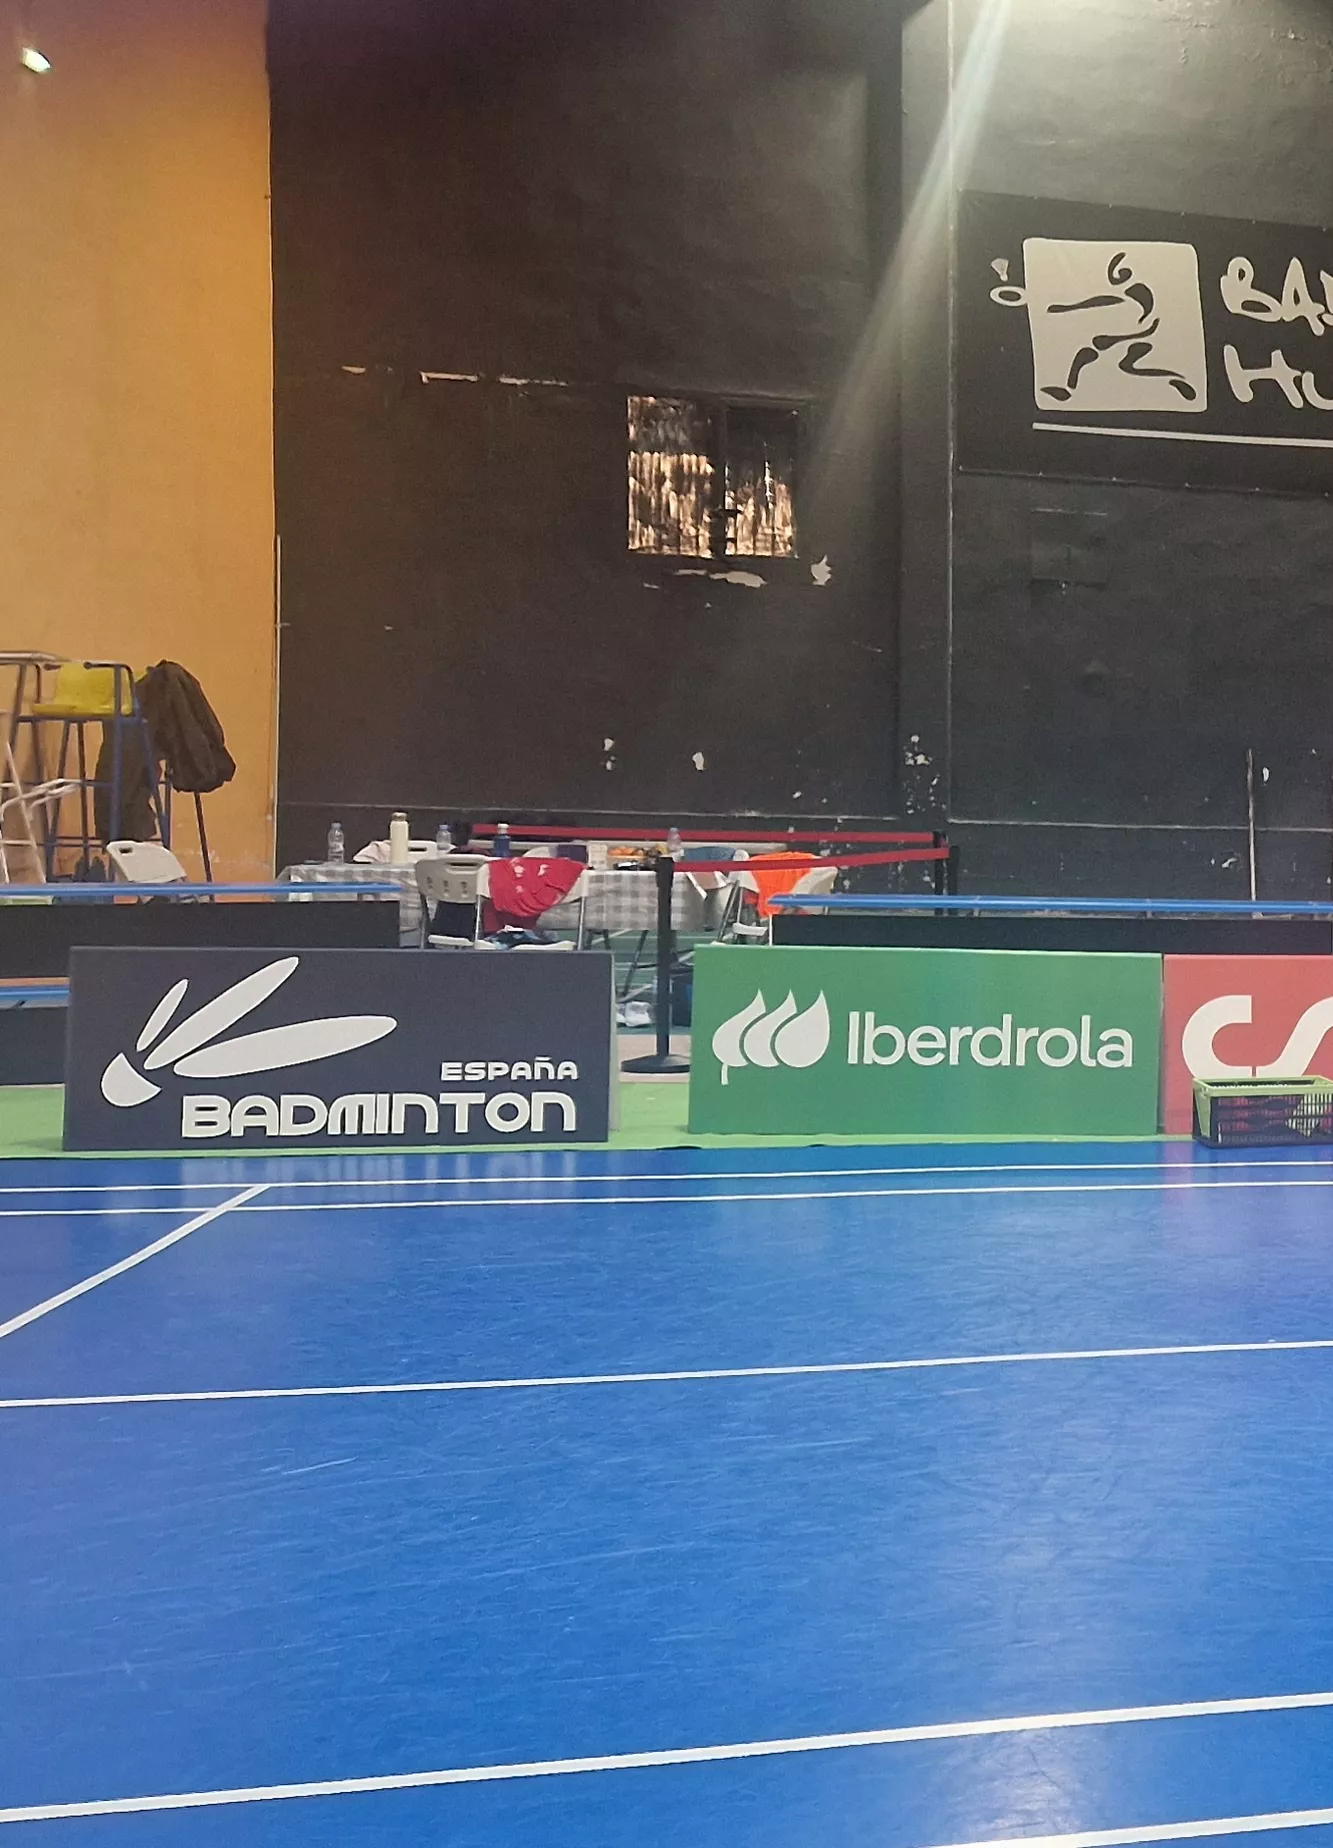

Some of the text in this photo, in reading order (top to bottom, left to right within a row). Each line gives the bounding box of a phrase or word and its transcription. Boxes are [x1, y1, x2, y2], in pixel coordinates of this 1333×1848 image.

[846, 1010, 1135, 1069] Iberdrola
[440, 1056, 579, 1082] ESPAÑA
[181, 1090, 577, 1139] BADMINTON
